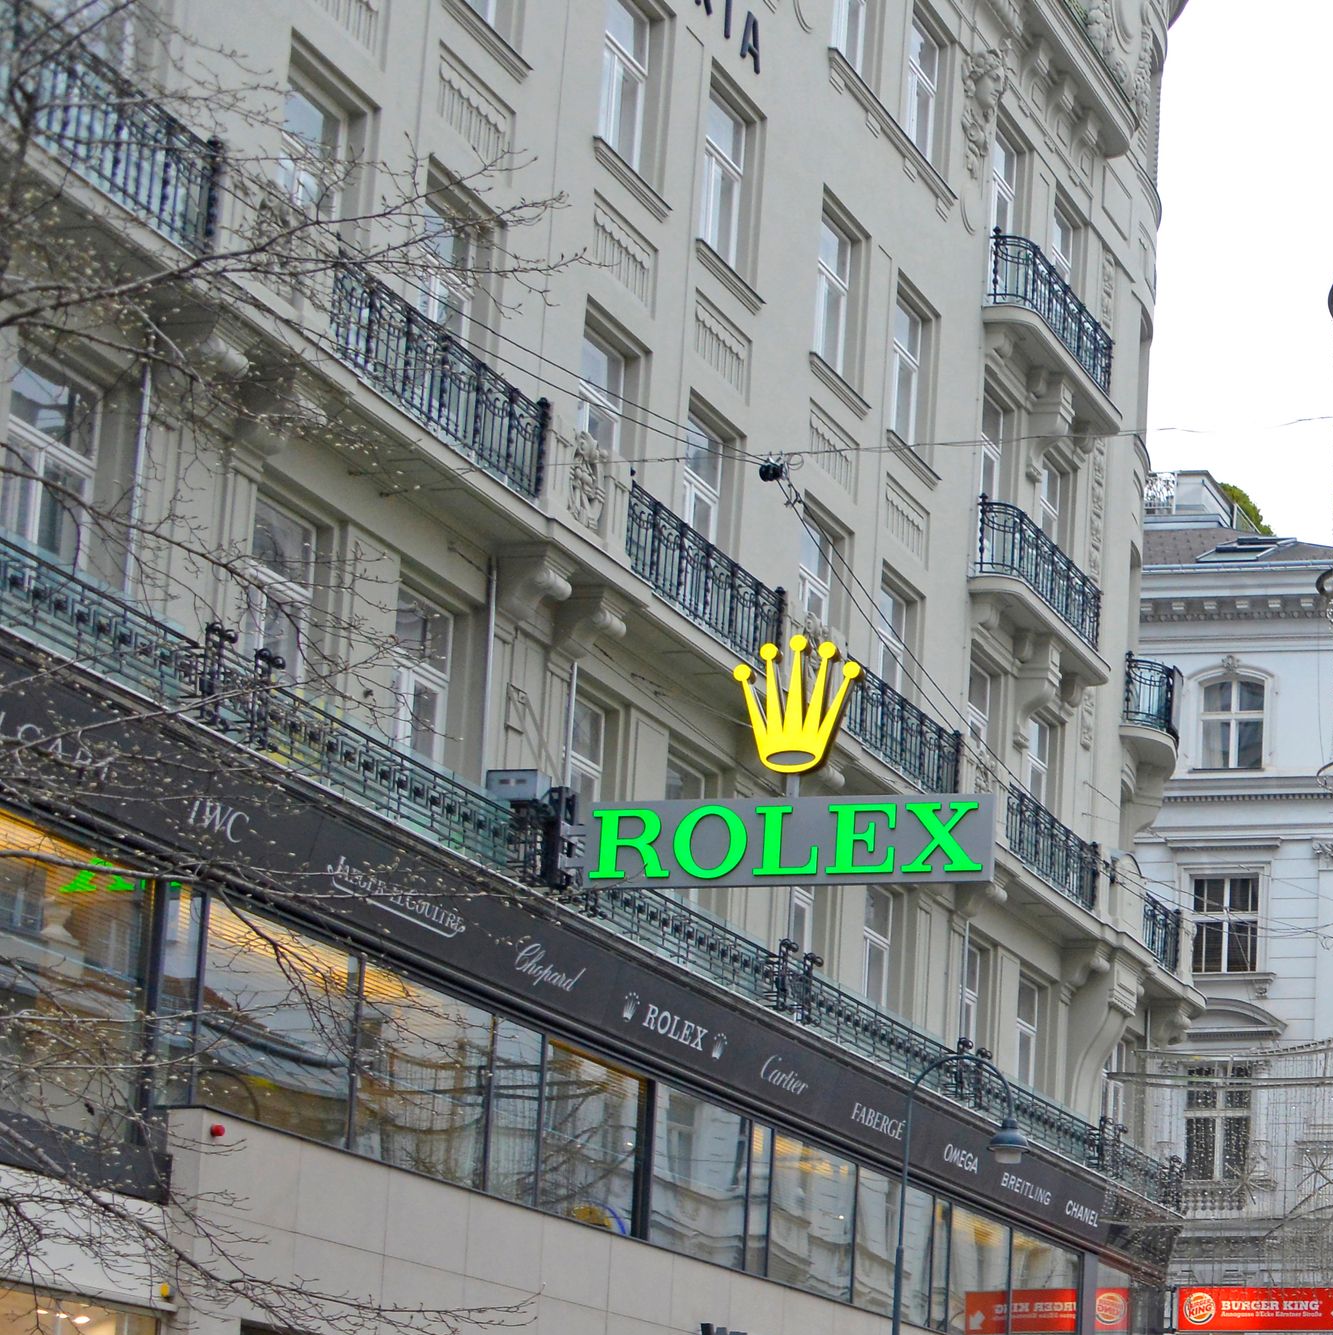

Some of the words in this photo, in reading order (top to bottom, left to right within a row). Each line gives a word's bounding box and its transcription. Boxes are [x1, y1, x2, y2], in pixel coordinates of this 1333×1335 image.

[694, 0, 760, 75] IA
[188, 799, 250, 844] IWC
[588, 801, 983, 880] ROLEX
[514, 940, 586, 992] Chopard
[642, 1003, 708, 1052] ROLEX
[760, 1054, 809, 1095] Cartier
[851, 1102, 906, 1141] FABERGÉ
[943, 1144, 979, 1174] OMEGA
[1001, 1172, 1052, 1206] BREITLING
[1065, 1200, 1099, 1228] CHANEL
[1189, 1305, 1213, 1317] KING
[1221, 1300, 1281, 1310] BURGER
[1283, 1300, 1321, 1310] KING
